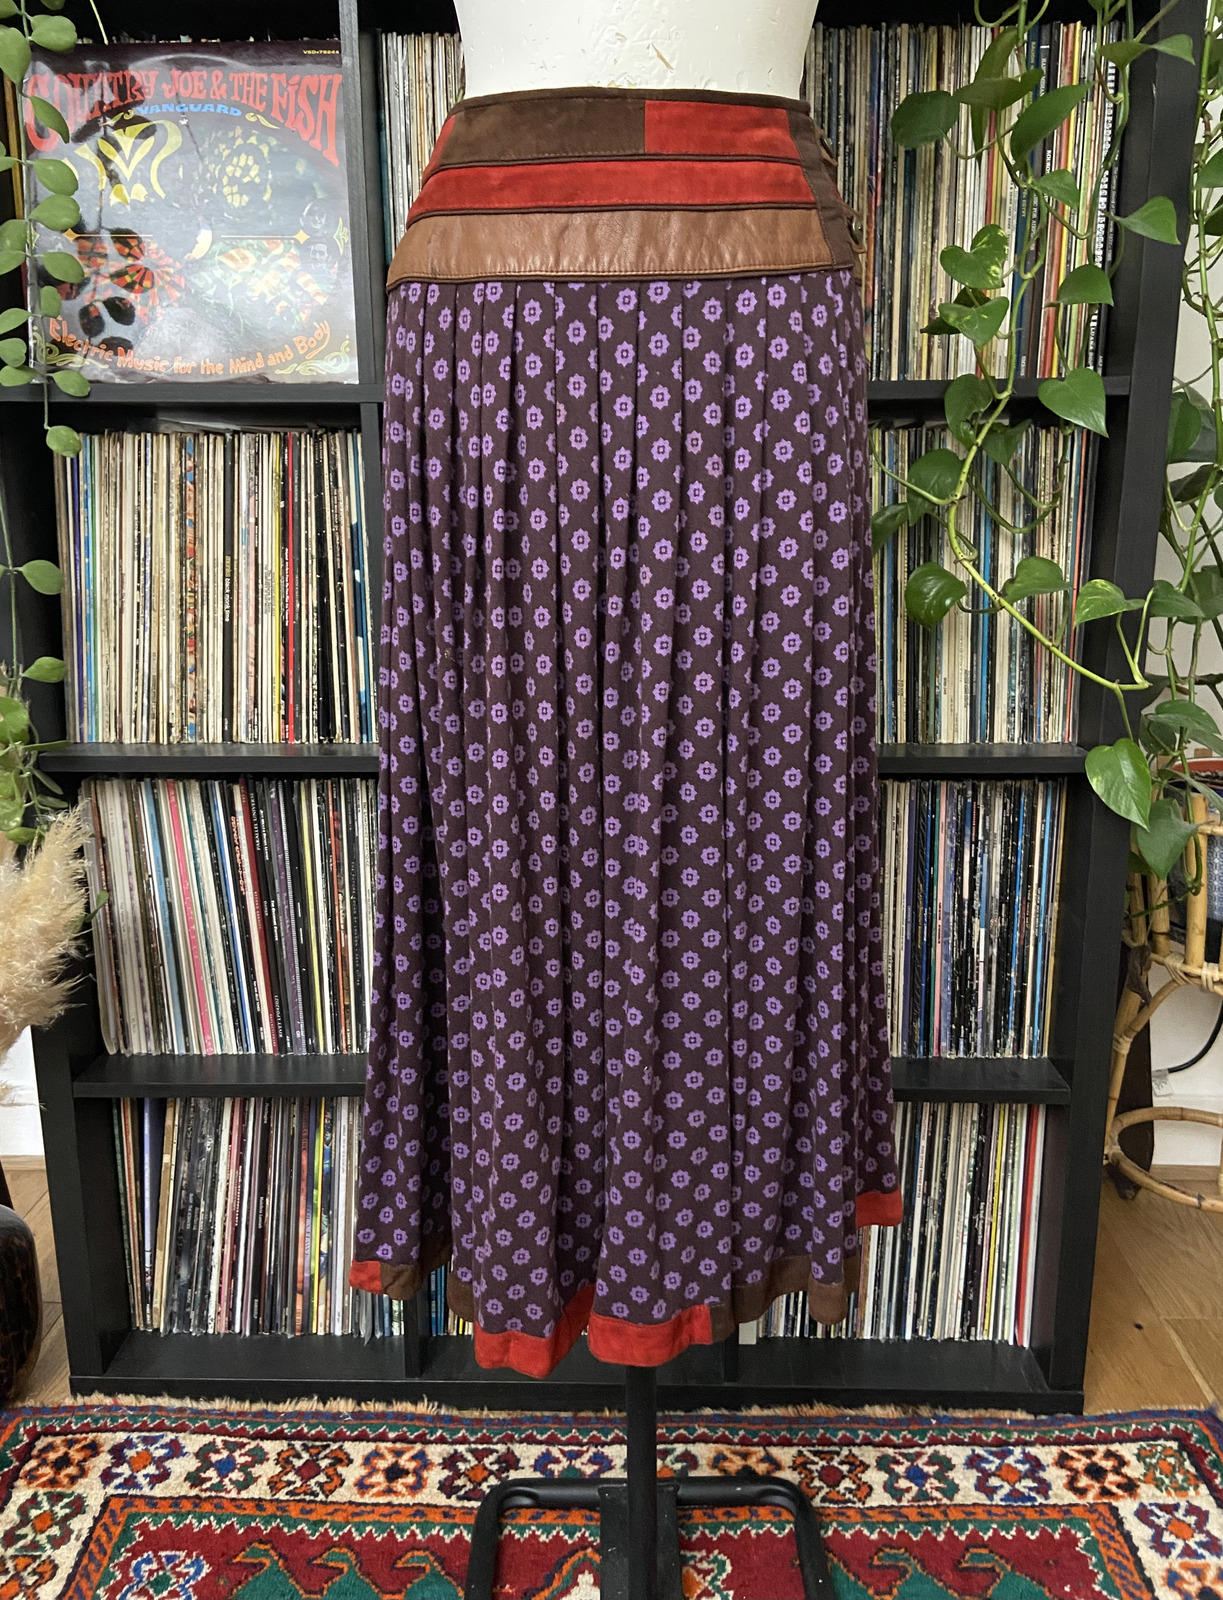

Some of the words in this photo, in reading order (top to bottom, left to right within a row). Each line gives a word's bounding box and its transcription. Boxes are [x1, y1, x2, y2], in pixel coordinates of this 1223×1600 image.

[136, 103, 242, 117] VANGUARD
[162, 69, 207, 99] JOE
[210, 69, 227, 99] &
[229, 72, 268, 112] THE
[49, 315, 114, 361] Electric
[117, 346, 170, 373] Music
[173, 355, 197, 374] for
[200, 358, 224, 375] the
[229, 352, 264, 374] Mind
[267, 344, 294, 367] and
[293, 320, 331, 359] Body
